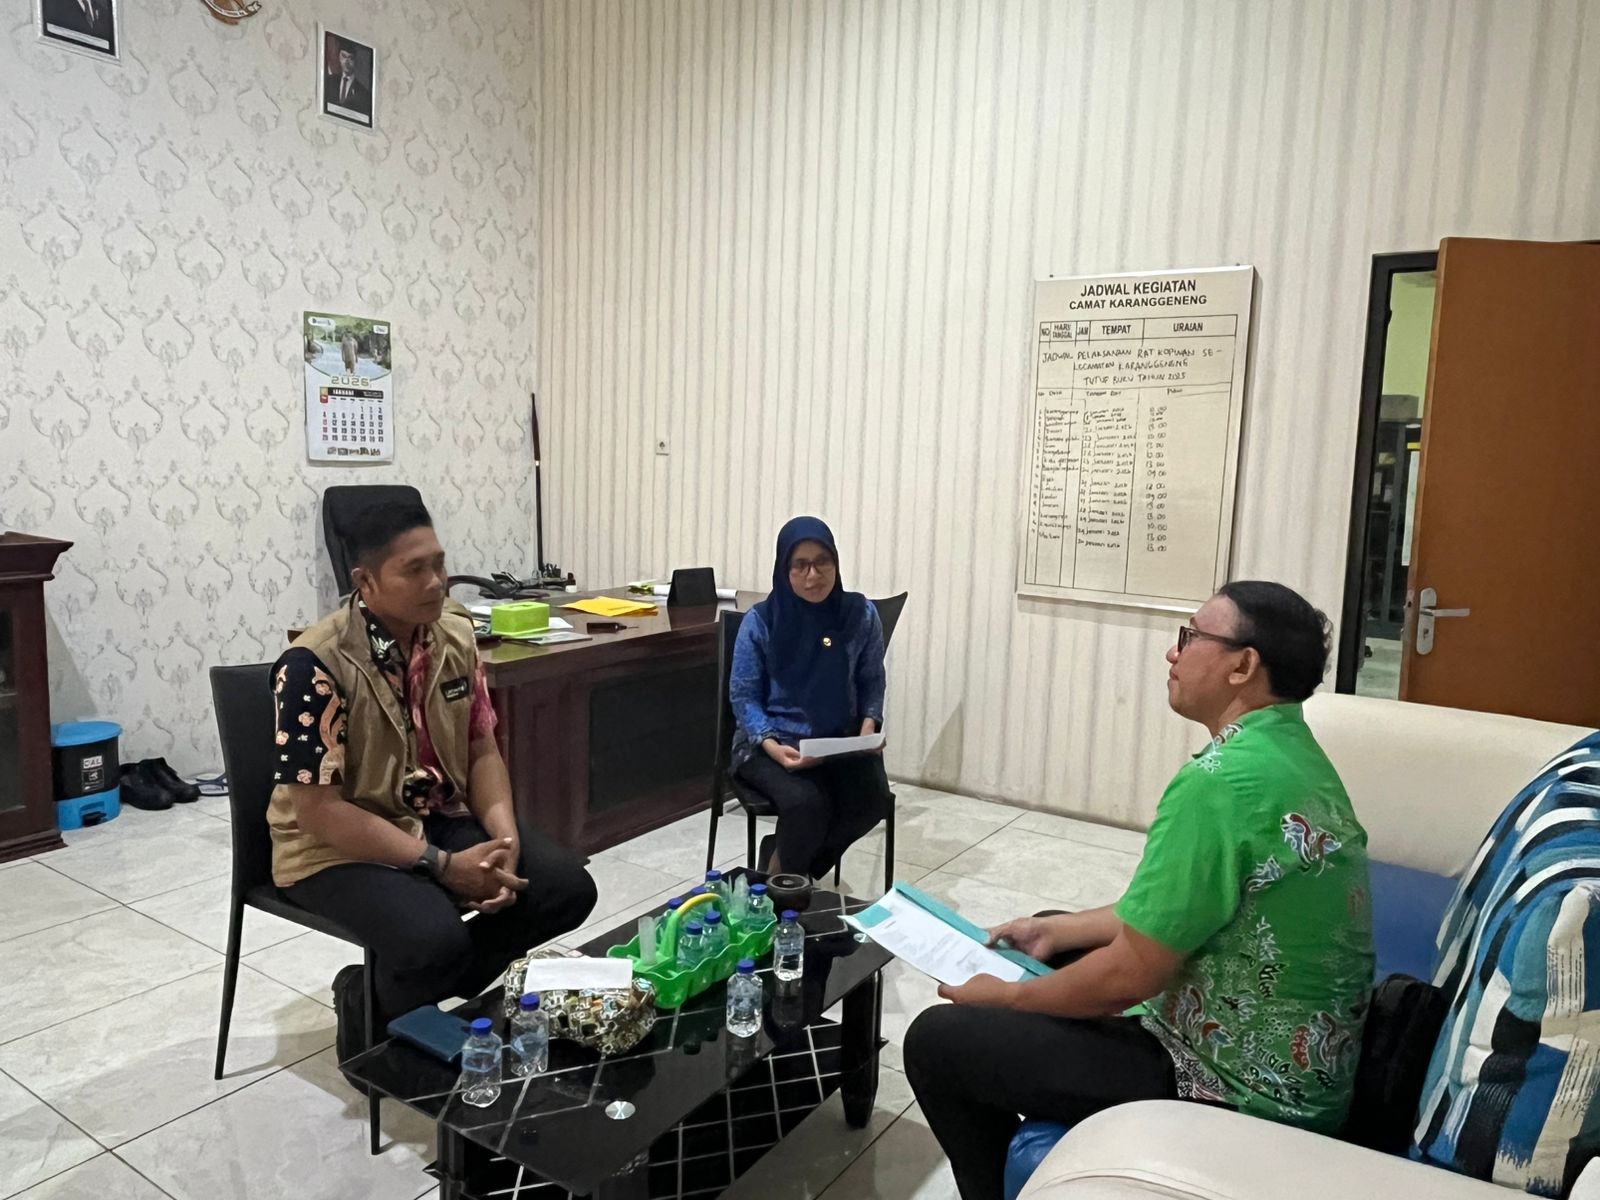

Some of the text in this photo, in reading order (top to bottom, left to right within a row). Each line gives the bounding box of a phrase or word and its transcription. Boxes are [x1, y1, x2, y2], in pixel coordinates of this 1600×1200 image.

[1080, 280, 1196, 297] JADWAL KEGIATAN
[1069, 295, 1207, 310] CAMAT KARANGGENENG
[1041, 328, 1051, 336] NO
[1077, 327, 1089, 335] JAM
[1102, 325, 1131, 335] TEMPAT
[1173, 322, 1203, 332] URAIAN
[1137, 348, 1154, 358] RAT
[331, 376, 369, 387] 2026
